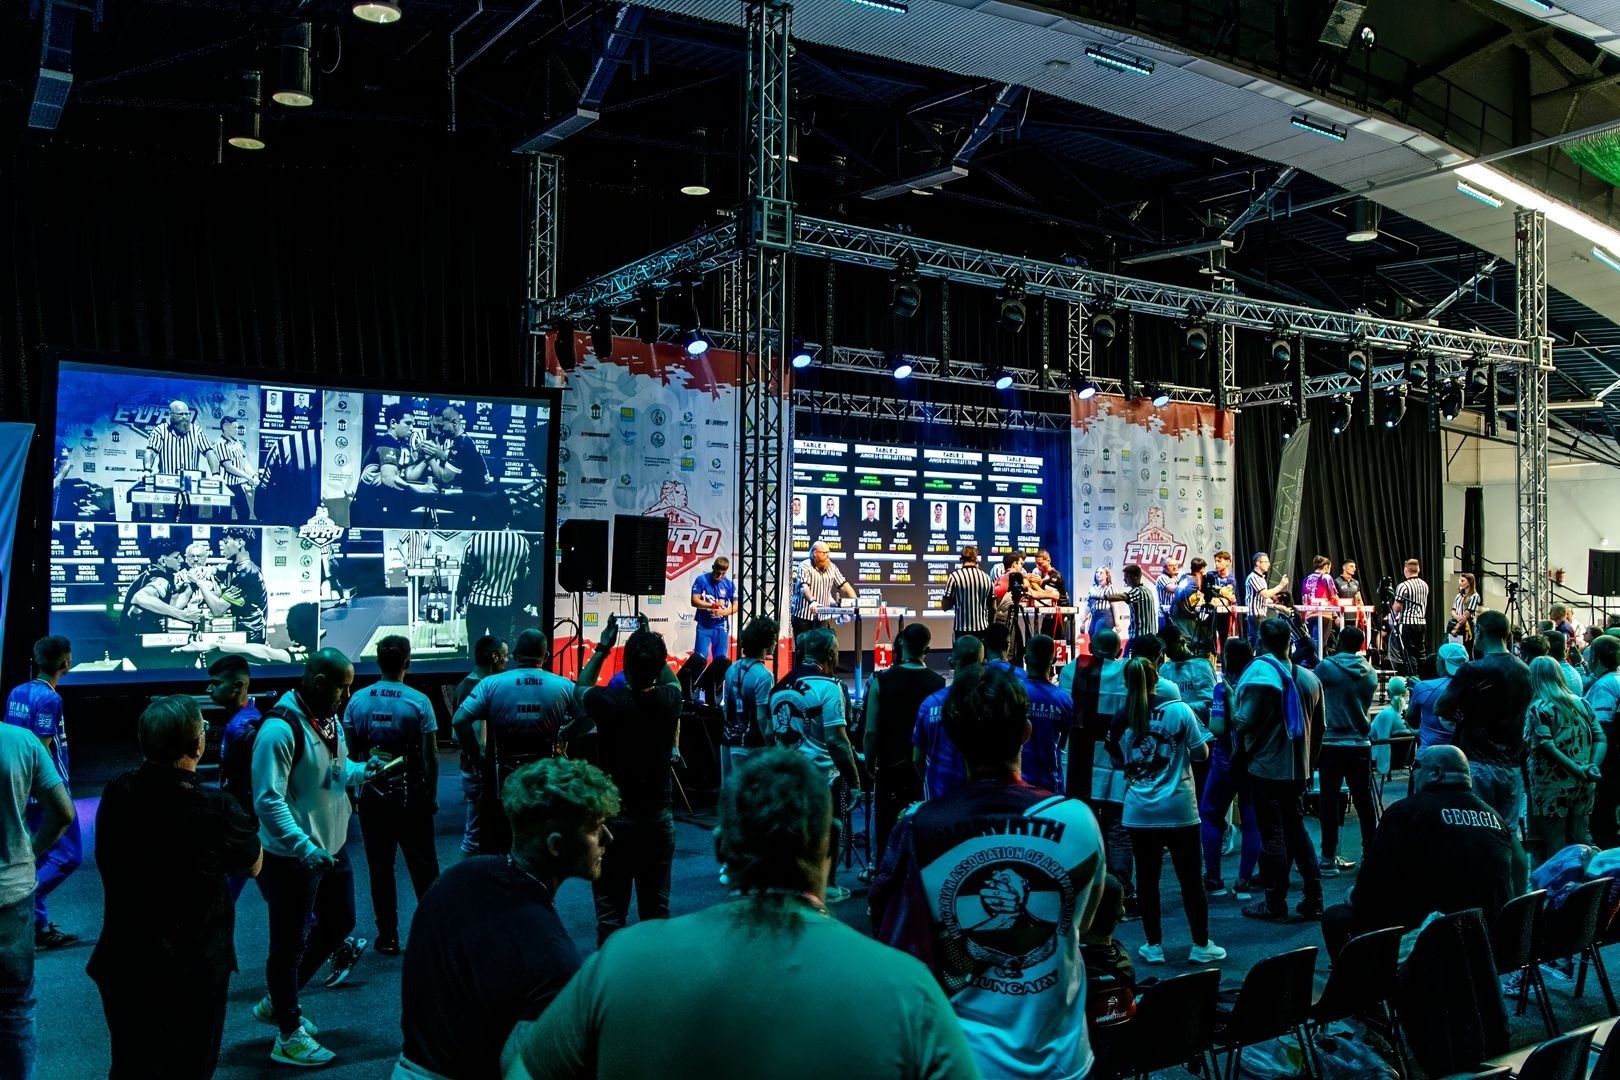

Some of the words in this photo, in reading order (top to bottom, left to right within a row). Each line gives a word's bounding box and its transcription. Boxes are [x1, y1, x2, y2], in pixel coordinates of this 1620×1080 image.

[298, 526, 344, 539] EURO
[1124, 544, 1187, 565] EURO
[431, 609, 439, 621] 4
[880, 651, 888, 664] 1
[1056, 646, 1064, 659] 2
[1441, 808, 1502, 830] GEORGIA
[1026, 850, 1043, 866] OF
